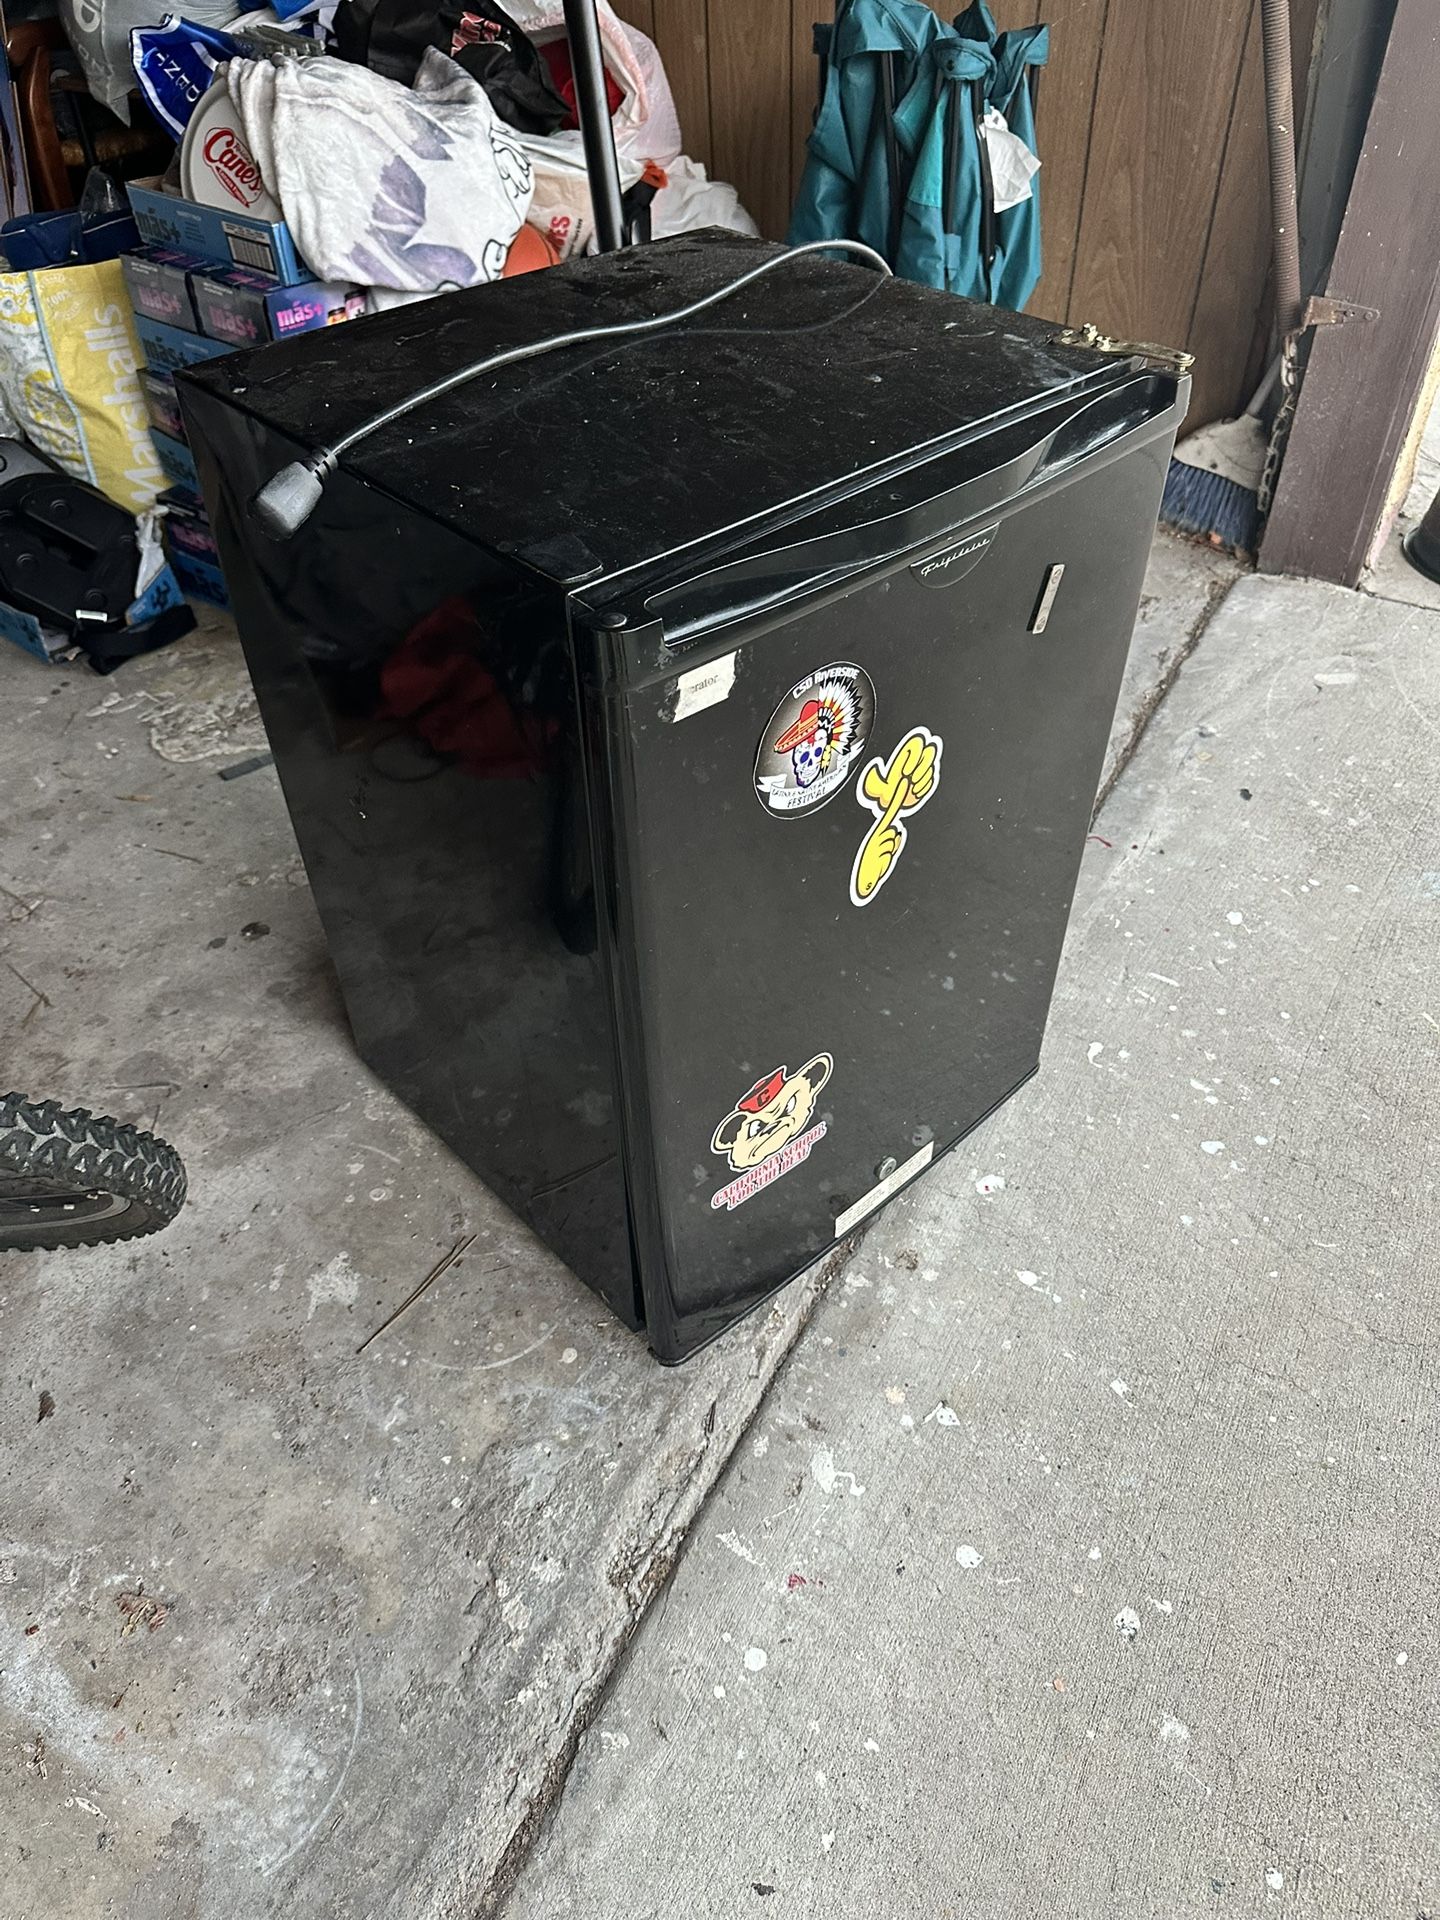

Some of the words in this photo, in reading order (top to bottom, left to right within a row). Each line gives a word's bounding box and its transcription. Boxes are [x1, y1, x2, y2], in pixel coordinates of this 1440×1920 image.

[276, 300, 324, 328] más+
[84, 303, 166, 504] Marshalls
[920, 538, 991, 577] Frigidaire
[792, 676, 813, 699] CSD
[814, 666, 860, 684] RIVERSIDE
[787, 786, 826, 808] FESTIVAL
[757, 1088, 771, 1107] C
[714, 1153, 780, 1206] CALIFORNIA
[780, 1122, 824, 1160] SCHOOL
[729, 1182, 756, 1208] FOR
[754, 1166, 779, 1190] THE
[780, 1143, 810, 1173] DEAF
